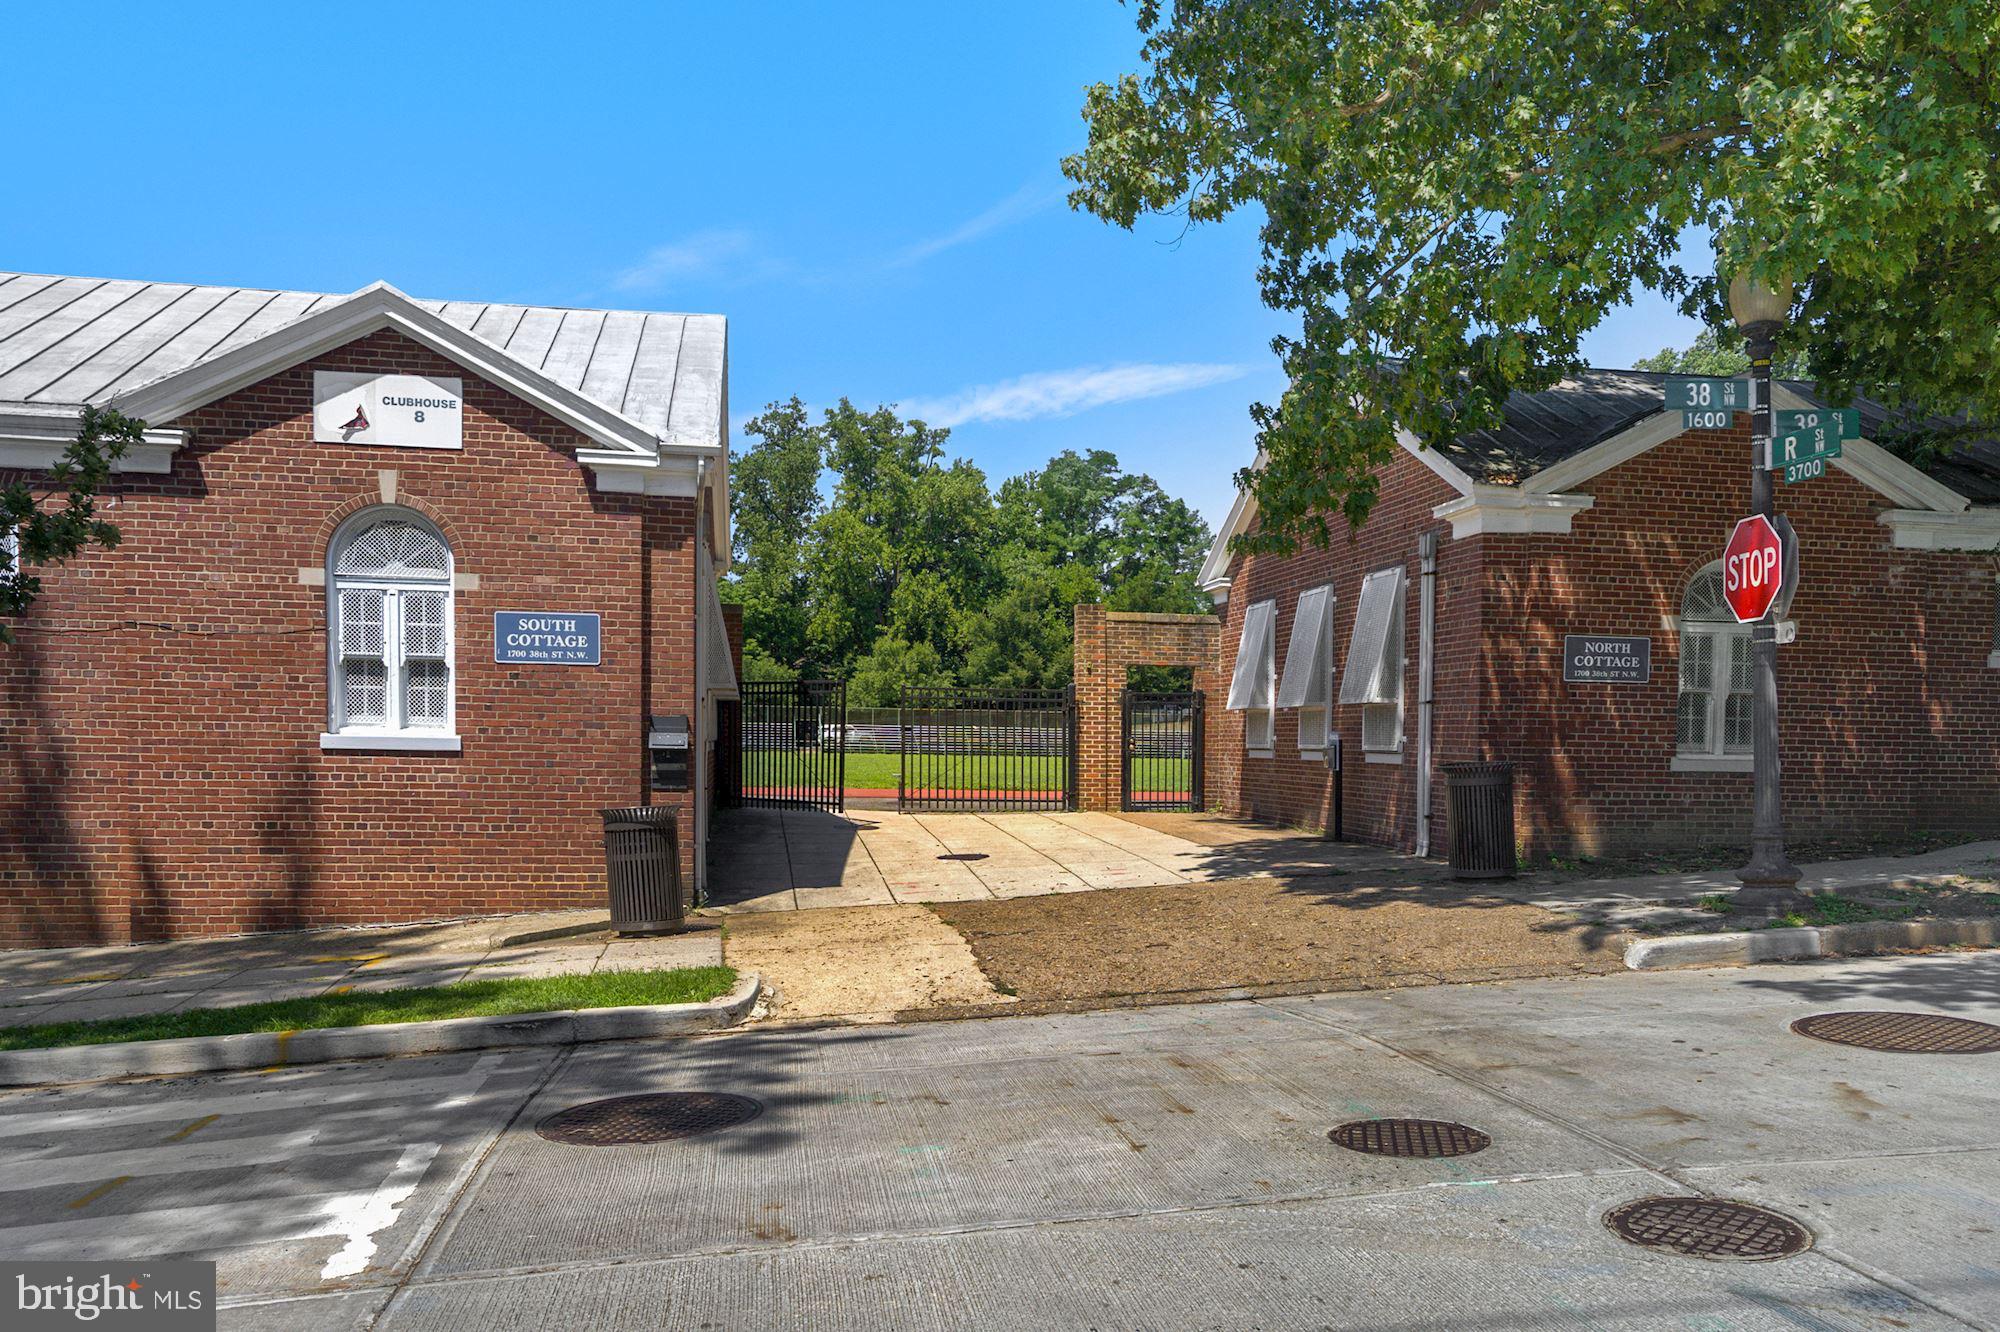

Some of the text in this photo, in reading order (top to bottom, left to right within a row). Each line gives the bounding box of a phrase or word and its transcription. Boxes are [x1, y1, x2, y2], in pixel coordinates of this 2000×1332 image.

[1686, 382, 1735, 406] 38 St
[1723, 394, 1735, 406] NW
[382, 396, 456, 409] CLUBHOUSE
[414, 411, 425, 423] 8
[1688, 412, 1726, 428] 1600
[1785, 428, 1824, 461] R St
[1815, 440, 1825, 453] NW
[1788, 460, 1820, 481] 3700
[1727, 546, 1777, 592] STOP
[518, 619, 576, 631] SOUTH
[507, 634, 588, 647] COTTAGE
[1585, 642, 1631, 654] NORTH
[507, 650, 588, 660] 1700 38th ST N.W.
[1574, 656, 1640, 667] COTTAGE
